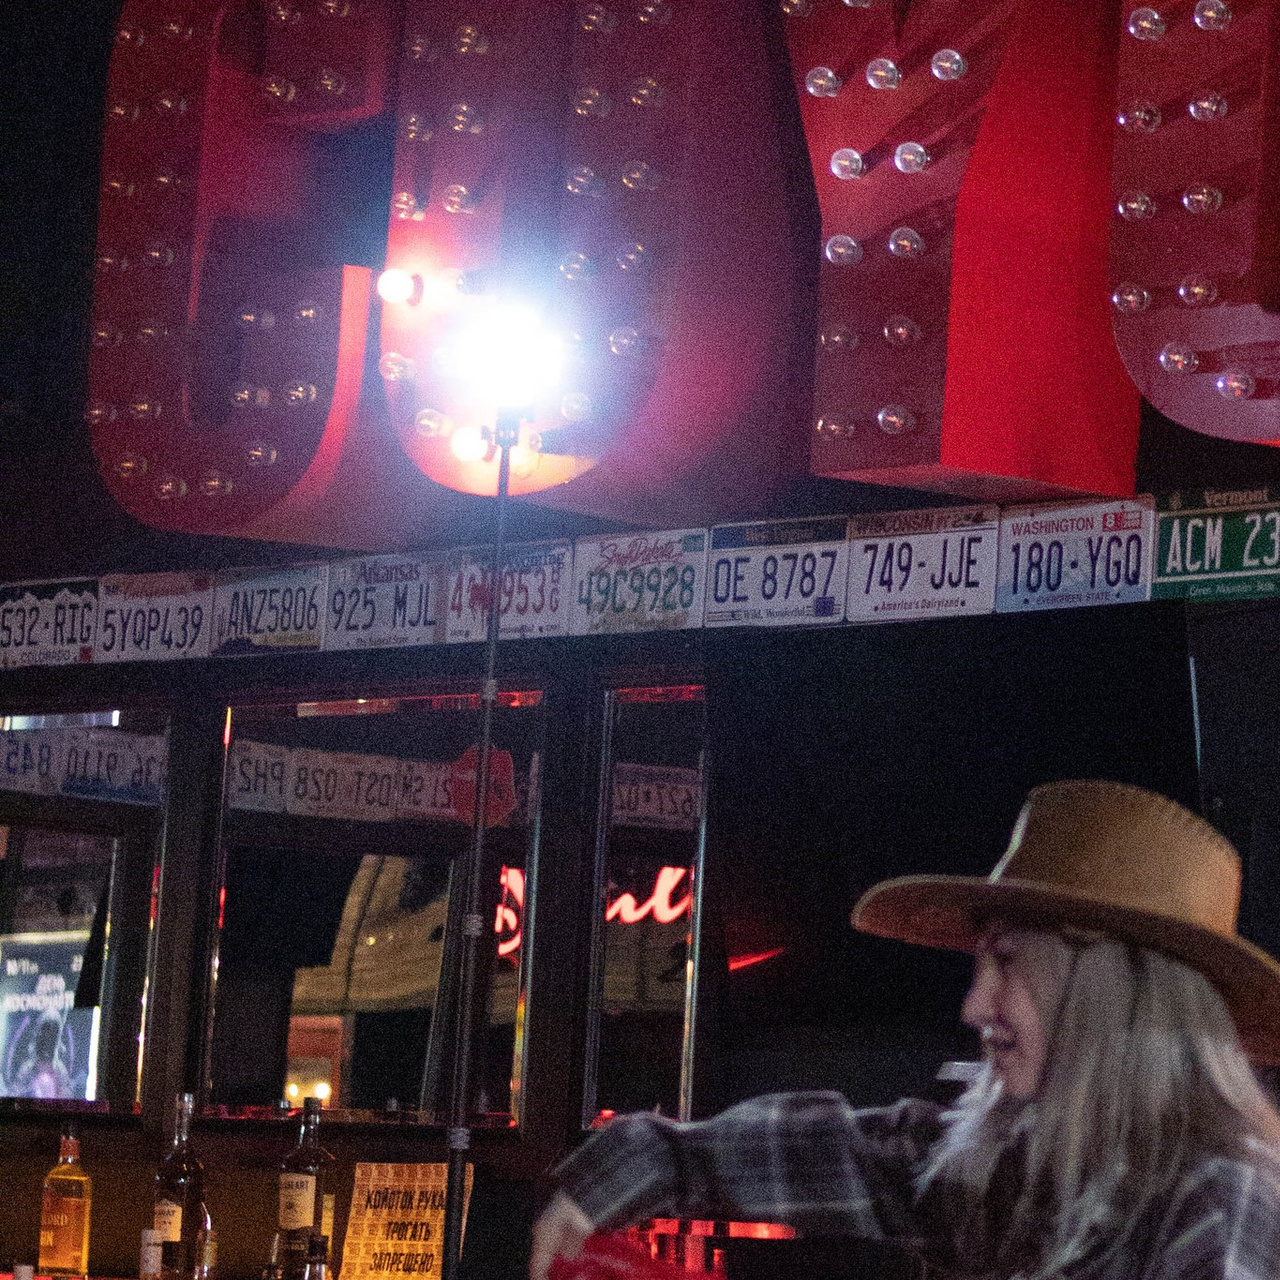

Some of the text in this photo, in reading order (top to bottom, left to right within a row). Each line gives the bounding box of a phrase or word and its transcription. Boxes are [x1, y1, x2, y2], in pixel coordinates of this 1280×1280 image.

[1204, 488, 1269, 507] Vermont
[1011, 518, 1094, 536] WASHINGTON
[1166, 517, 1224, 574] ACM
[358, 561, 420, 585] Arkansas
[762, 551, 837, 600] 8787
[864, 536, 982, 594] 749-JJE
[333, 583, 436, 631] 925 MJL
[578, 566, 696, 615] 49C9928
[229, 586, 320, 634] ANZ5806
[417, 1189, 446, 1210] РУКА
[385, 1221, 431, 1242] ТРОГАТЬ
[369, 1252, 434, 1275] ЗАПРЕЩЕНО
